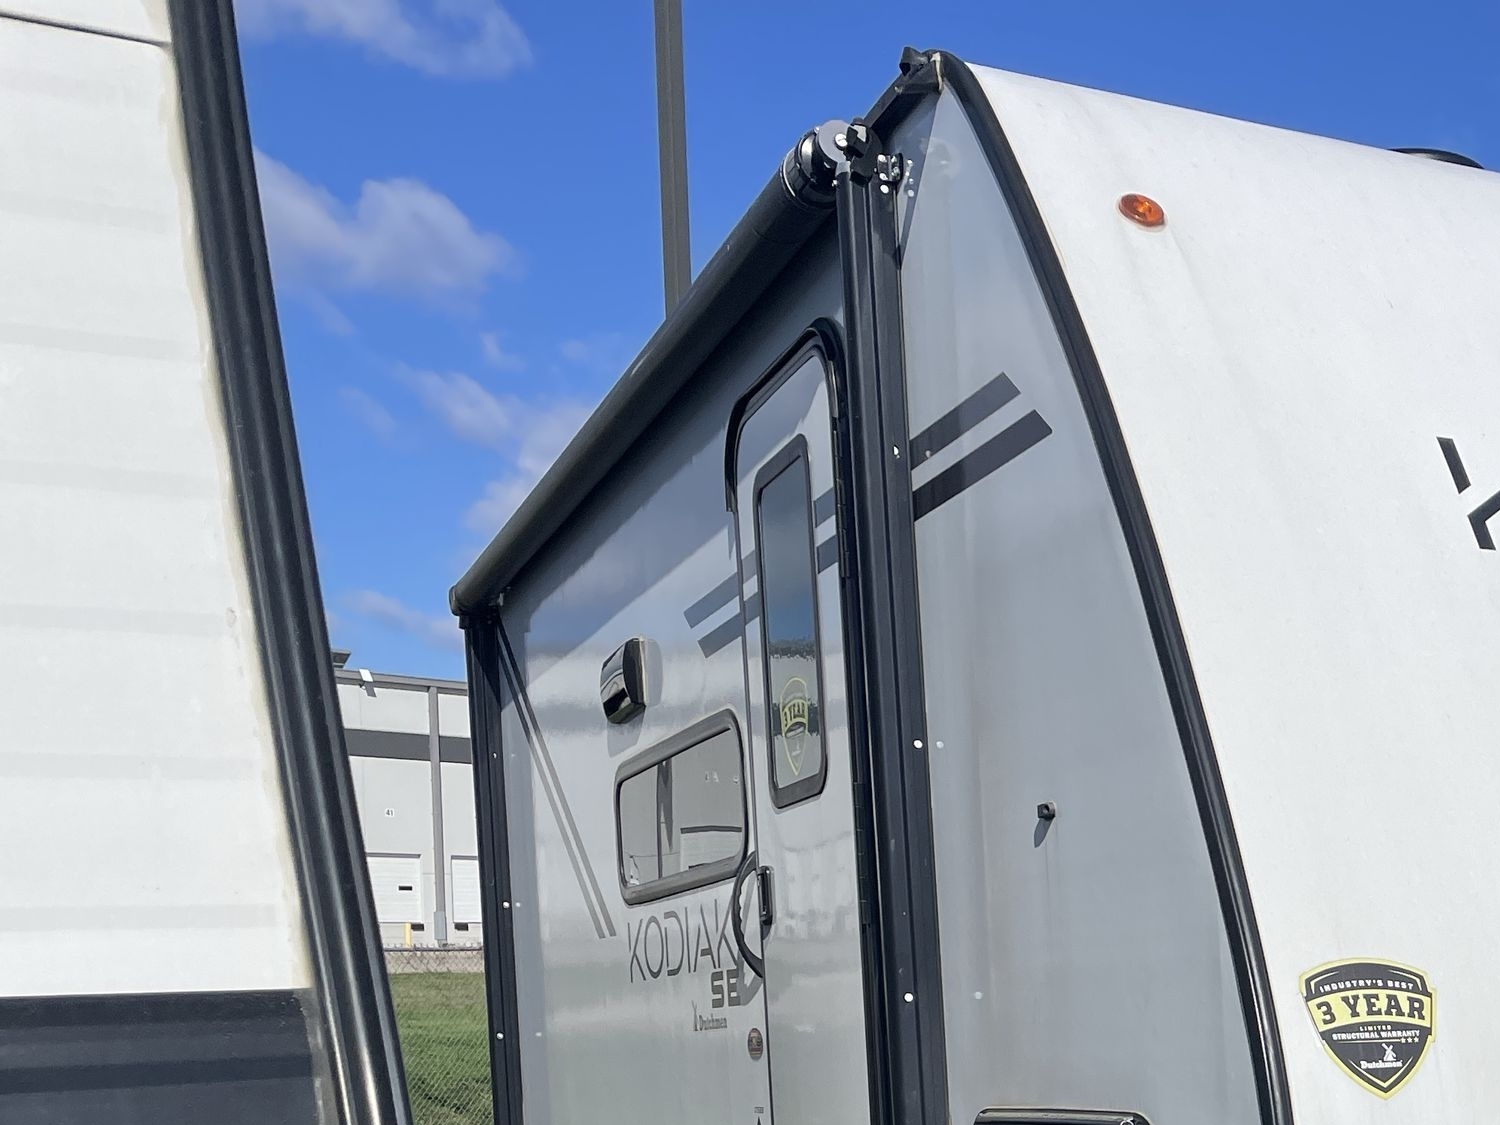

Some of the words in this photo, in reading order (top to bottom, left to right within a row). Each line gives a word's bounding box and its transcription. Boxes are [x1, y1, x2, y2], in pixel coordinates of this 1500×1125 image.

[627, 898, 738, 983] KODIAK
[711, 968, 742, 1009] SE
[1319, 979, 1383, 993] INDUSTRY'S
[1387, 980, 1414, 990] BEST
[1315, 1001, 1337, 1025] 3
[1341, 993, 1426, 1021] YEAR
[1359, 1024, 1392, 1032] LIMITED
[1332, 1031, 1379, 1041] STRUCTURAL
[1380, 1030, 1420, 1039] WARRANTY
[1359, 1060, 1403, 1070] Dutchmen
